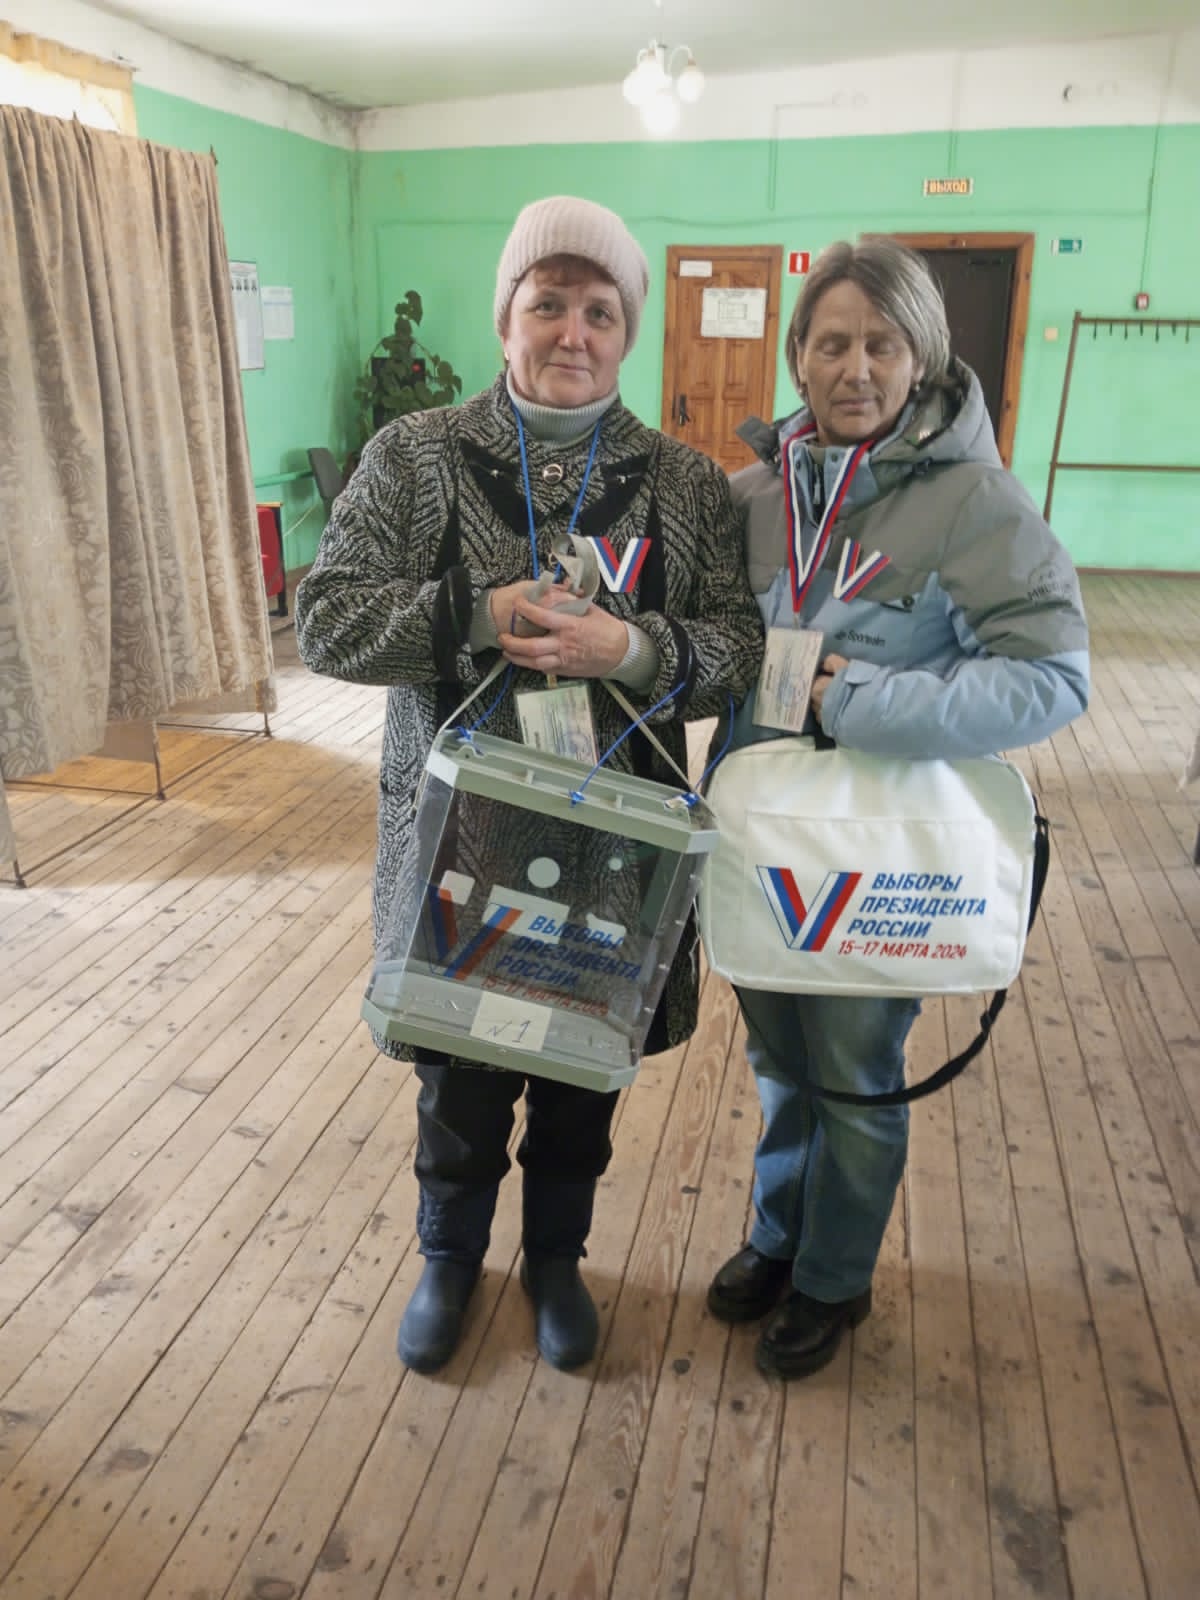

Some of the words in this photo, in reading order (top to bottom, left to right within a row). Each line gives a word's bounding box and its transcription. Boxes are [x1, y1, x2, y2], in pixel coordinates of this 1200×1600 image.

[872, 873, 963, 892] ВЫБОРЫ
[859, 897, 987, 917] ПРЕЗИДЕНТА
[528, 914, 625, 950] ВЫБОРЫ
[847, 919, 932, 939] РОССИИ
[511, 935, 642, 981] ПРЕЗИДЕНТА
[879, 942, 930, 958] МАРТА
[931, 943, 967, 960] 2024
[496, 954, 581, 988] РОССИИ
